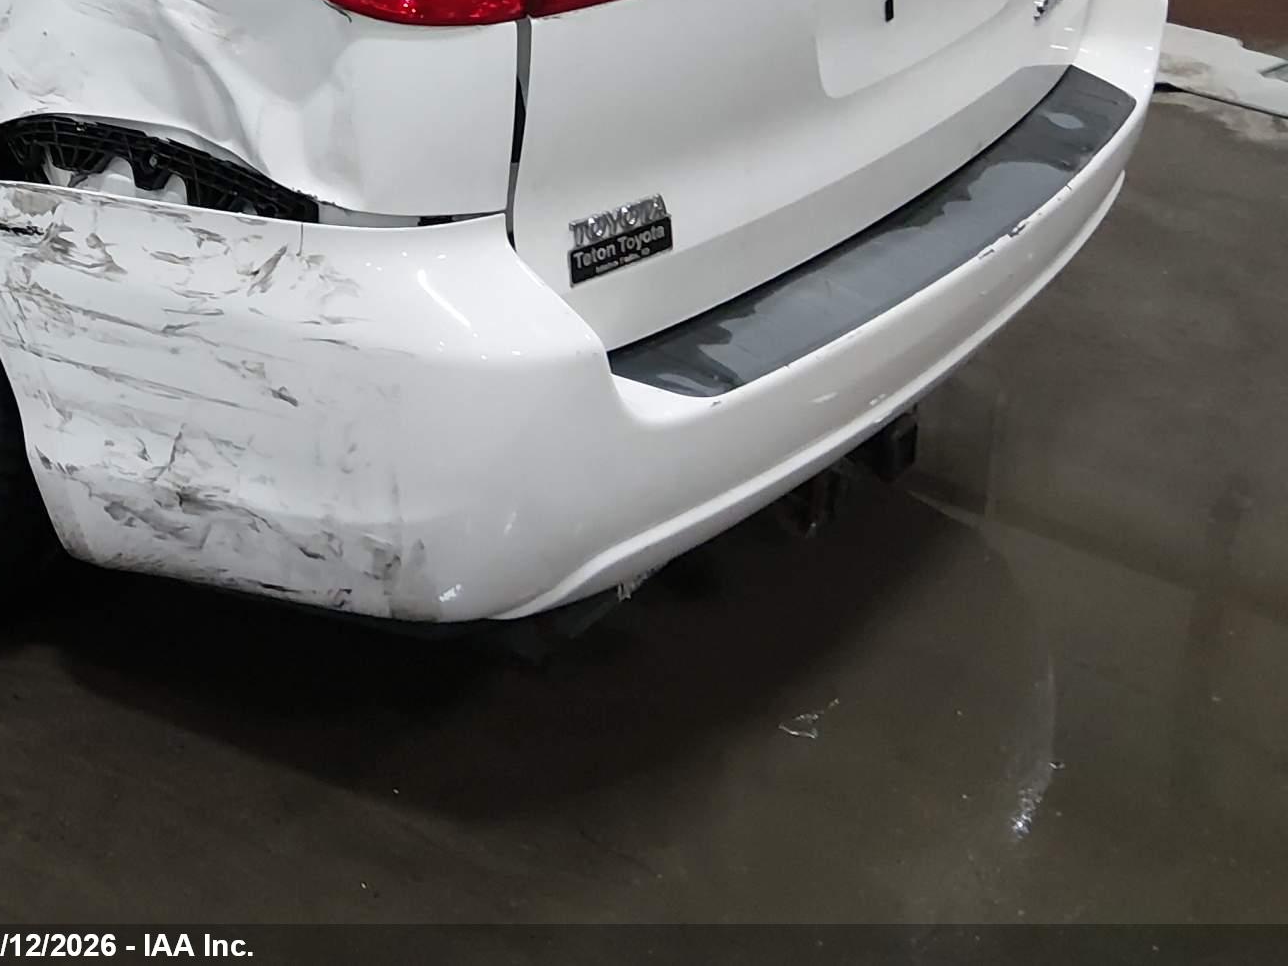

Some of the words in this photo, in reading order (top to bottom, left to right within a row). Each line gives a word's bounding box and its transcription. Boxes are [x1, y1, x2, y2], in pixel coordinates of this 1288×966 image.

[569, 194, 668, 247] TOYOTA
[572, 244, 616, 269] Teton
[617, 225, 665, 253] Toyota
